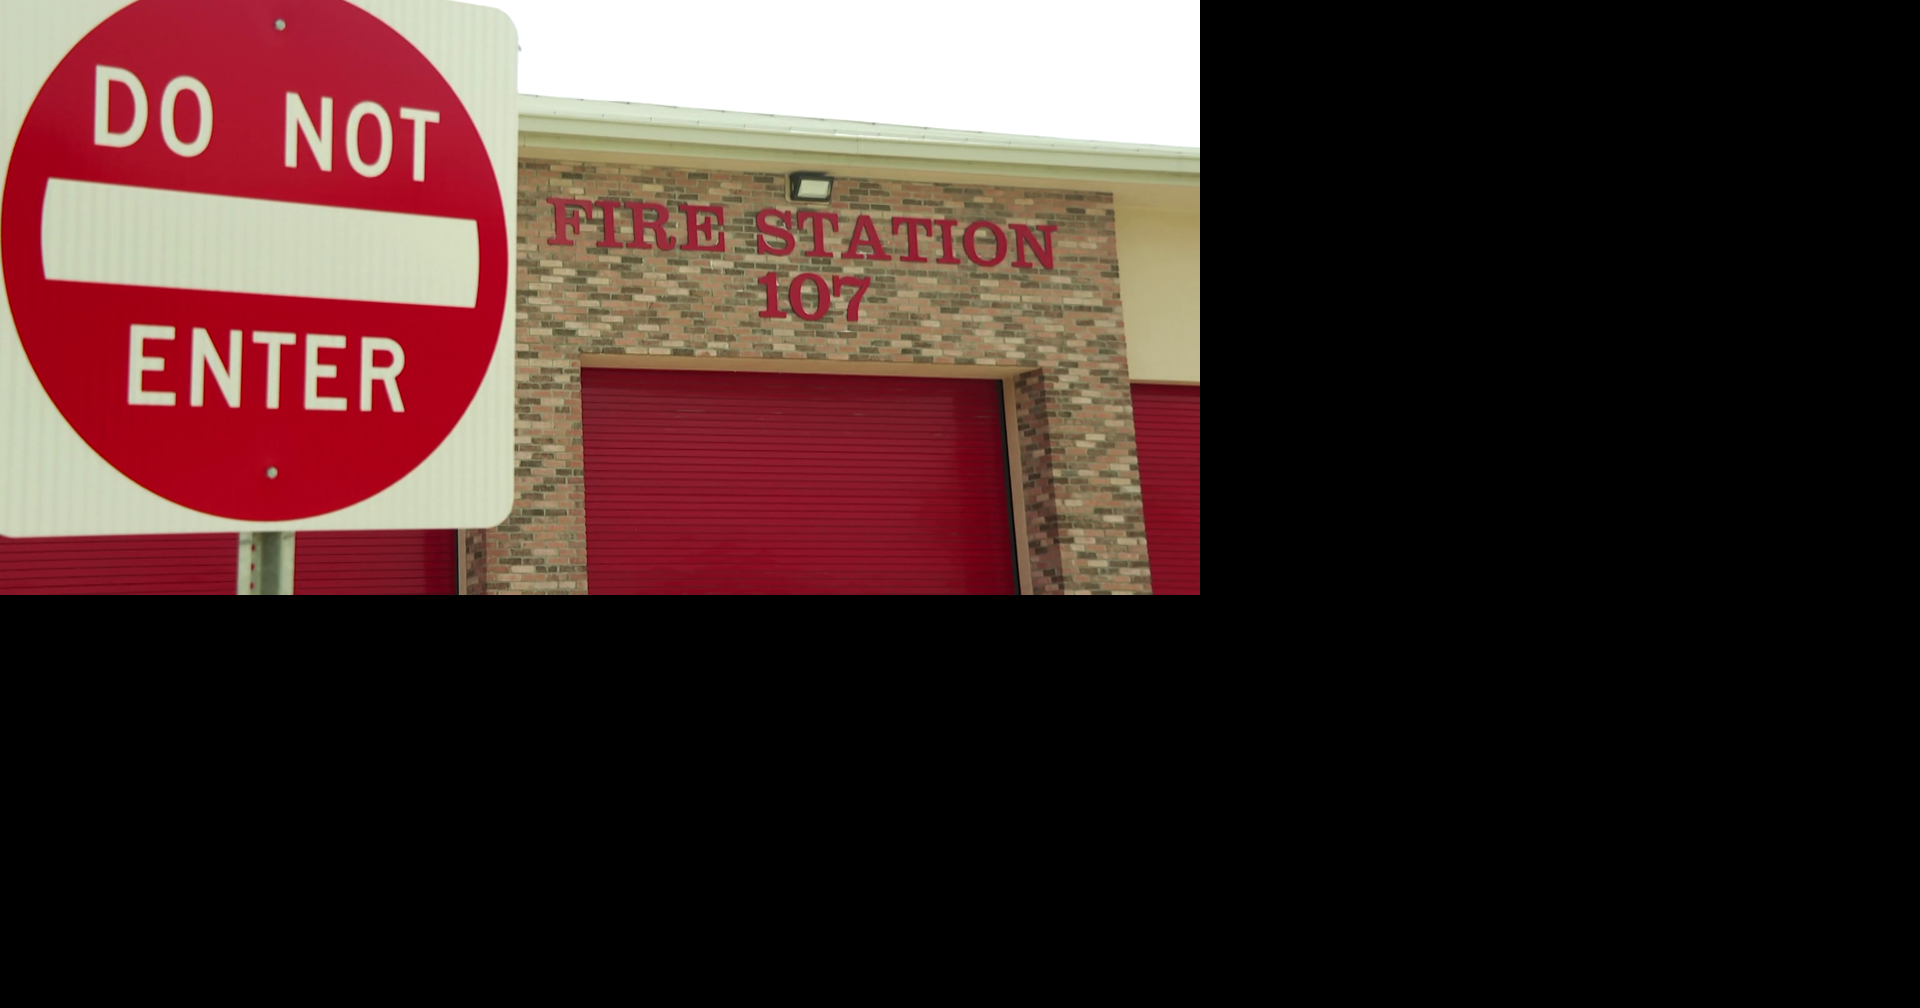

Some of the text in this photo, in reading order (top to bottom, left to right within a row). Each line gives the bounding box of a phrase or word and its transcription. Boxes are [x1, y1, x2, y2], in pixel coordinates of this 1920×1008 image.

[94, 64, 441, 183] DO NOT
[546, 197, 1058, 270] FIRE STATION
[757, 271, 871, 322] 107
[127, 323, 406, 413] ENTER
